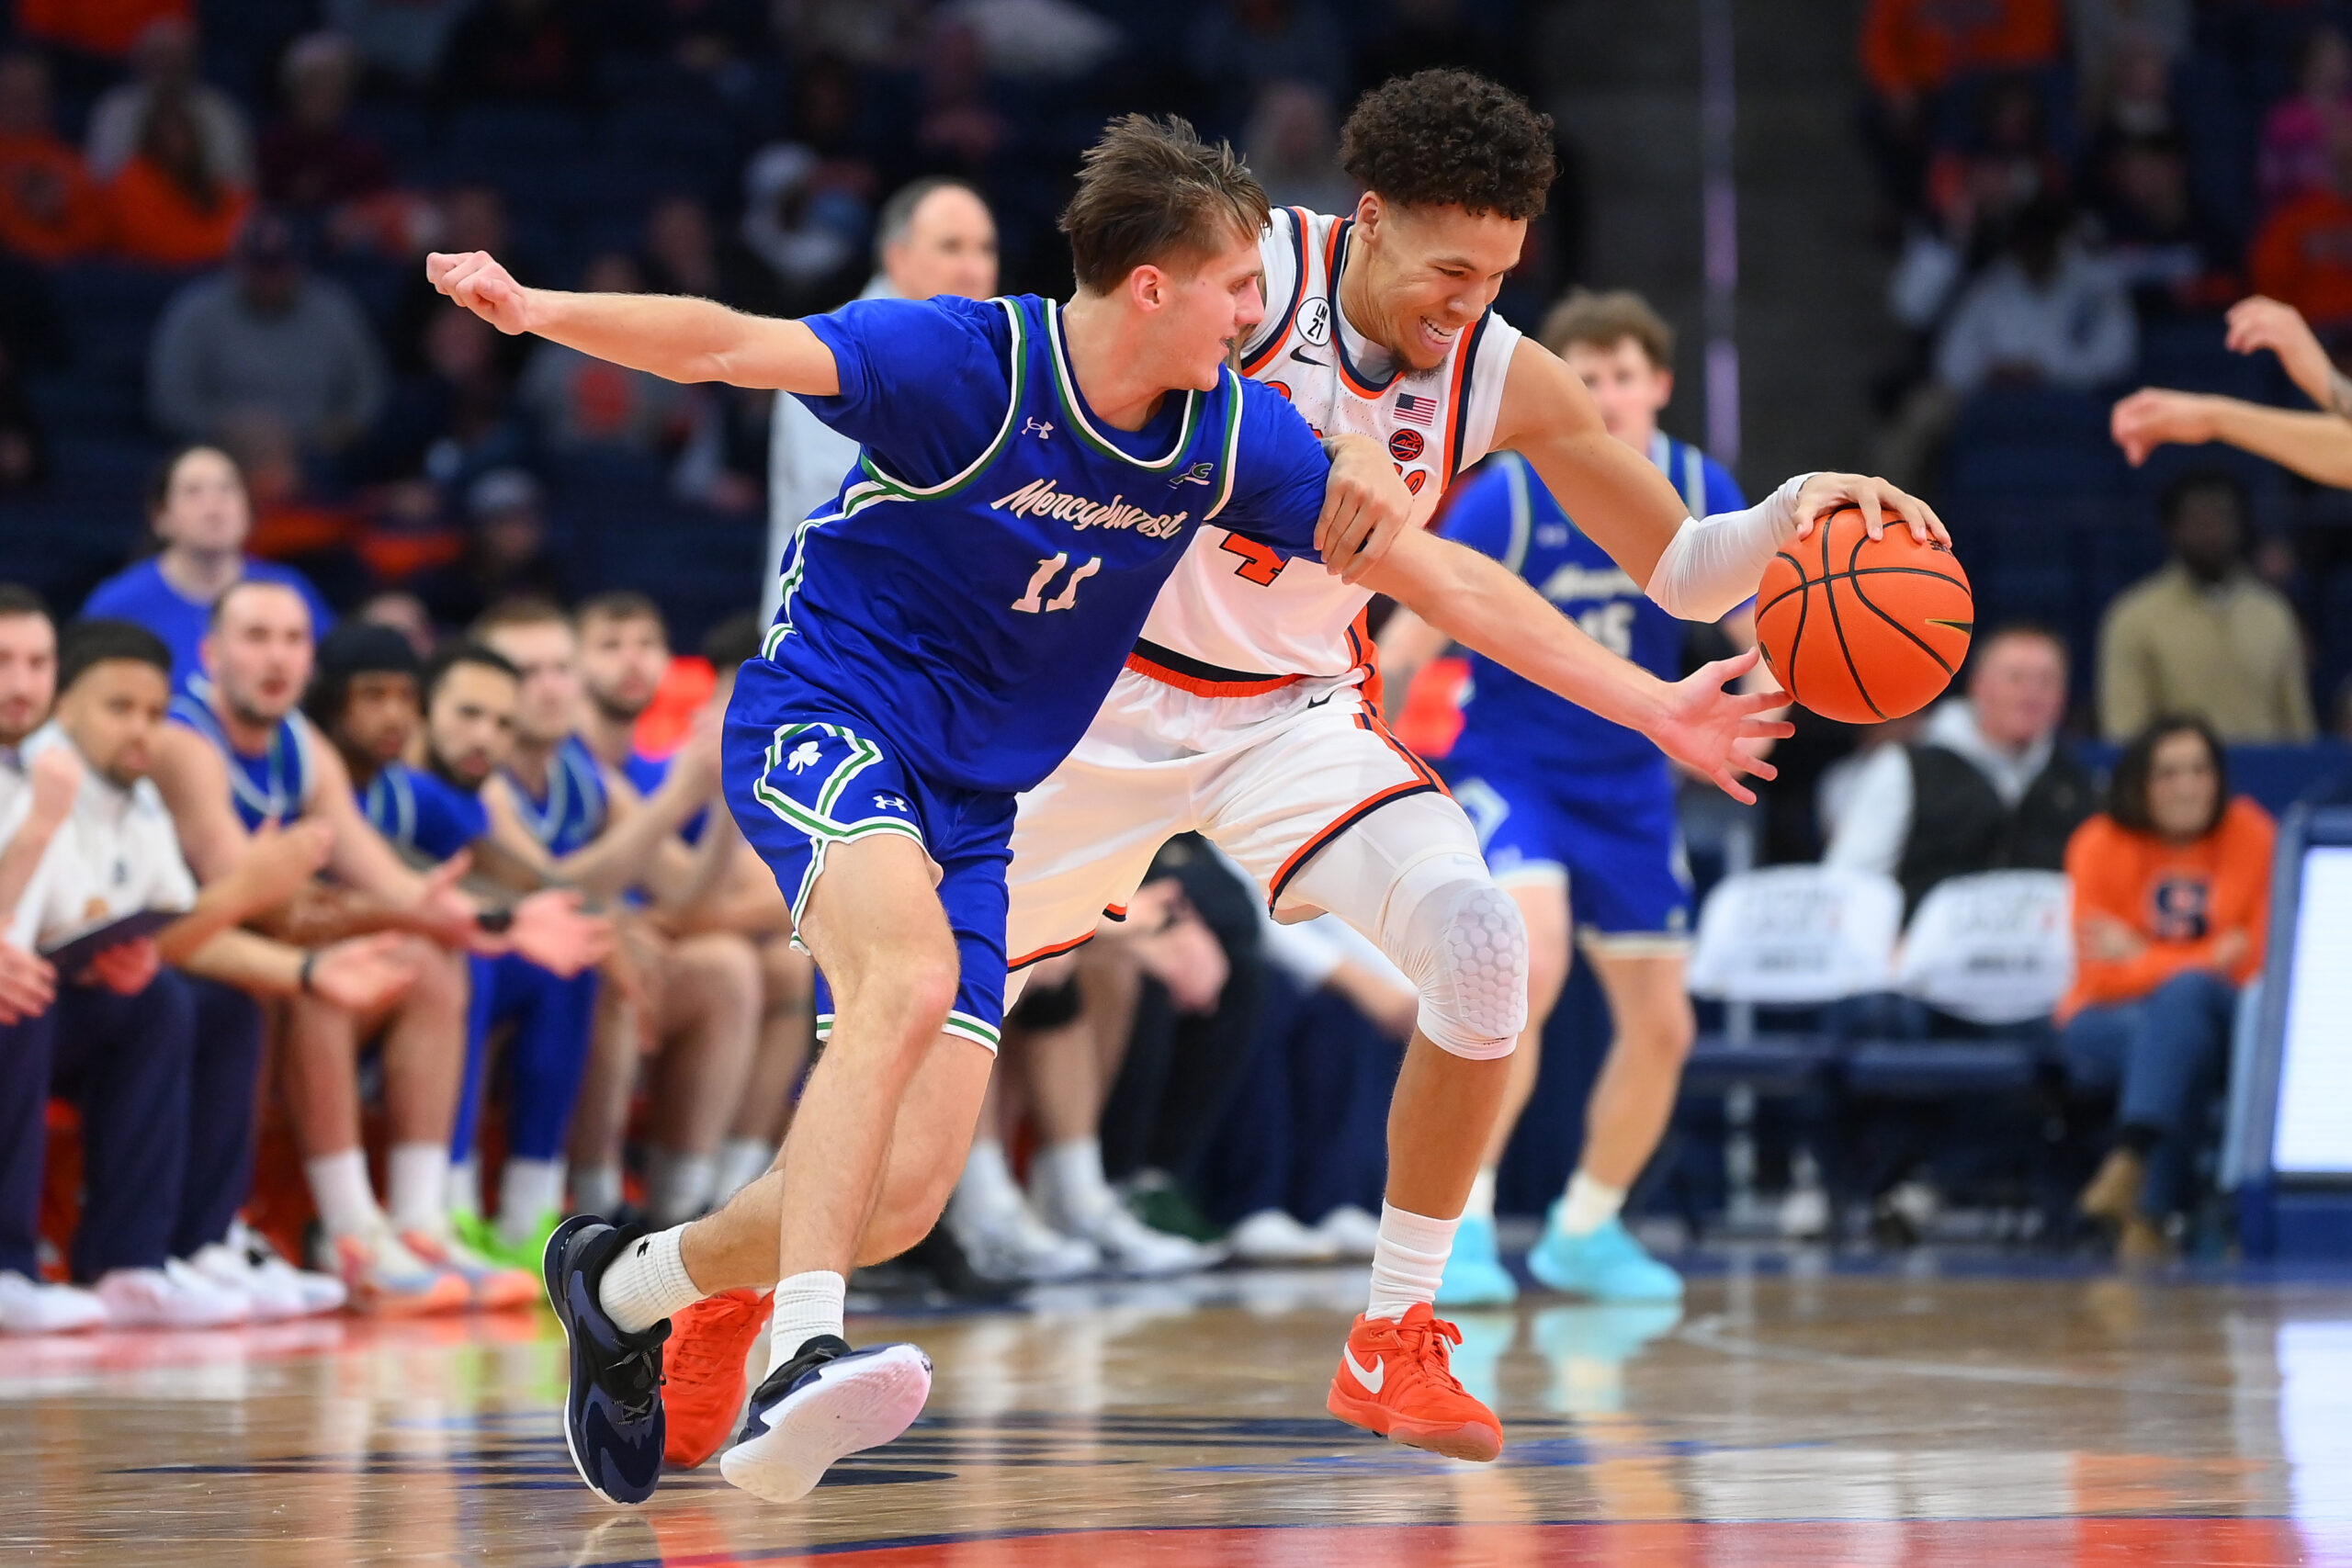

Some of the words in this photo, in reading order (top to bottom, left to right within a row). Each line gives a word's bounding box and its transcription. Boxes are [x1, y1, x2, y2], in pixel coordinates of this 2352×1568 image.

[1306, 317, 1324, 340] 21
[1396, 439, 1420, 450] ACC
[989, 478, 1188, 539] Mercyhurst
[1011, 552, 1102, 614] 11
